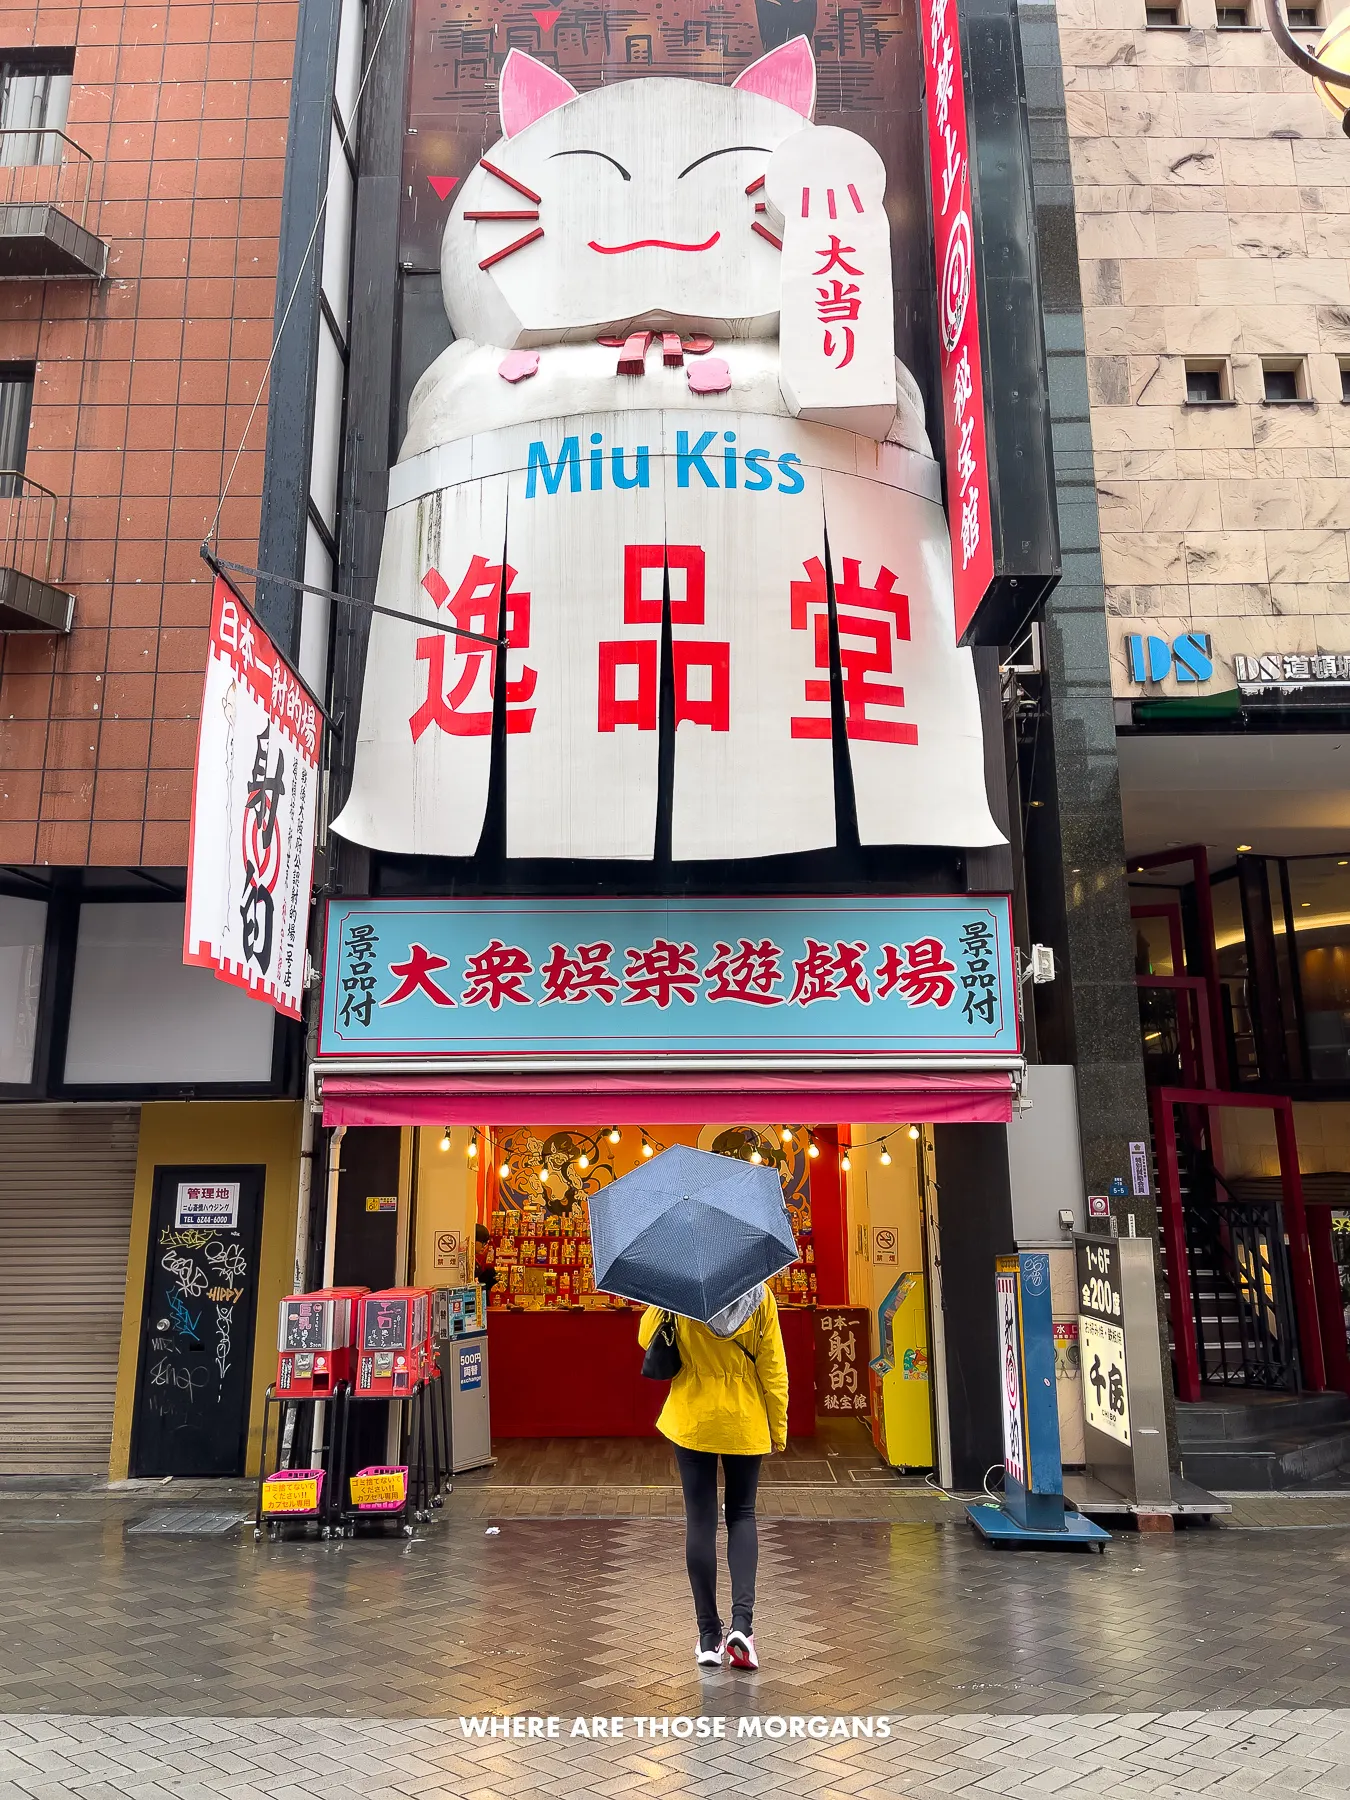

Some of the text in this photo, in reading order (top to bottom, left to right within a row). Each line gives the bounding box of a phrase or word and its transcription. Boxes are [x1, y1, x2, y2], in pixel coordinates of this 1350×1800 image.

[812, 234, 864, 370] 大当り
[525, 429, 805, 500] Miu Kiss
[953, 345, 979, 570] 秘宝館
[409, 544, 918, 746] 逸品堂
[1123, 633, 1214, 684] DS
[219, 597, 317, 749] 日本一射的場
[338, 923, 380, 1029] 景品付
[378, 936, 958, 1011] 大衆娯楽遊戯場
[958, 920, 999, 1026] 景品付
[187, 1188, 230, 1200] 管理地
[820, 1315, 860, 1331] 日本一
[460, 1352, 482, 1366] 500円
[463, 1365, 478, 1378] 両替
[828, 1330, 858, 1393] 射的
[460, 1375, 482, 1385] exchange
[1089, 1354, 1125, 1416] 千房
[824, 1394, 867, 1410] 秘宝館
[1101, 1409, 1117, 1422] CHIBO
[264, 1482, 315, 1492] ゴミ捨てないで
[352, 1476, 401, 1487] ゴミ捨てないで
[357, 1491, 399, 1502] カプセル専用
[268, 1499, 311, 1509] カプセル専用
